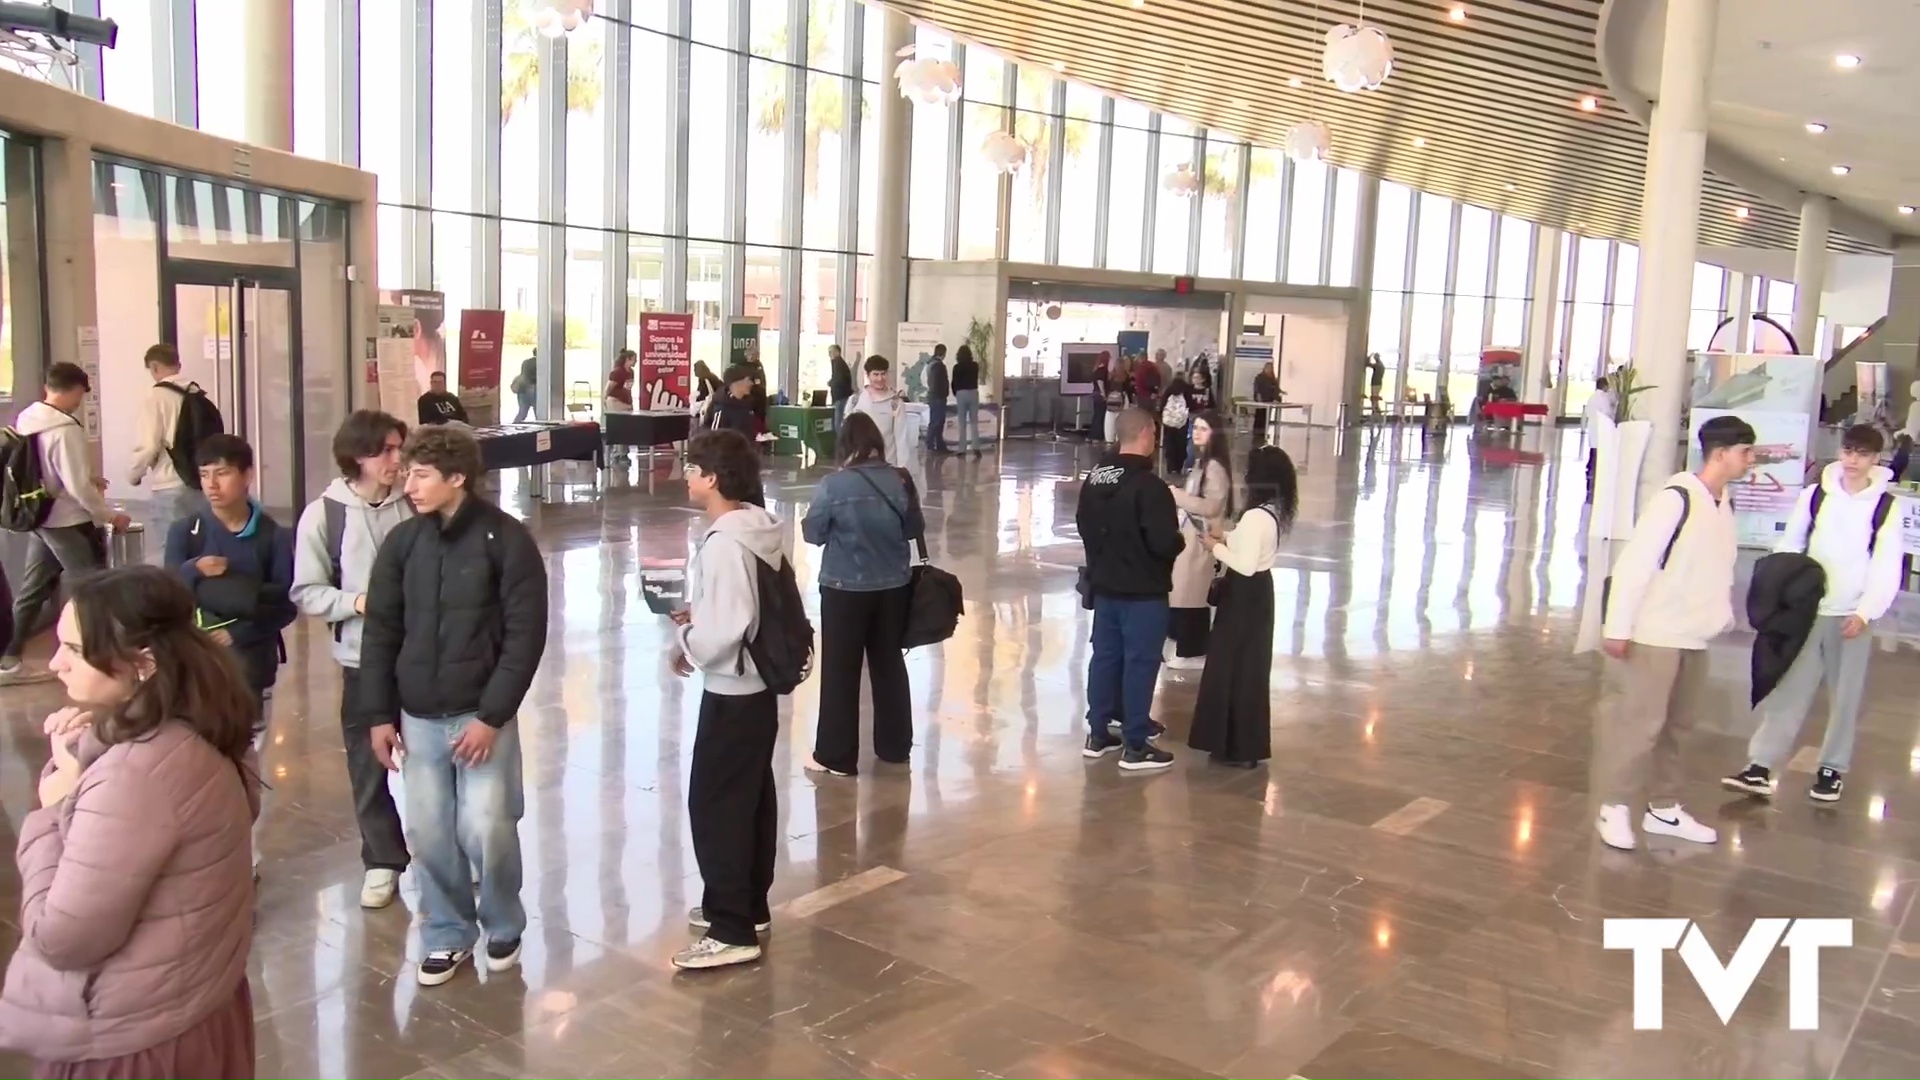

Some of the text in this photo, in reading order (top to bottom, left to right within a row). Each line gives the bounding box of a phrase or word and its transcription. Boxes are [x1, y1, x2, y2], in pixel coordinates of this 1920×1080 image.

[649, 335, 684, 343] Somos la
[644, 351, 688, 359] universidad
[642, 358, 690, 366] donde debes
[435, 401, 456, 414] UA
